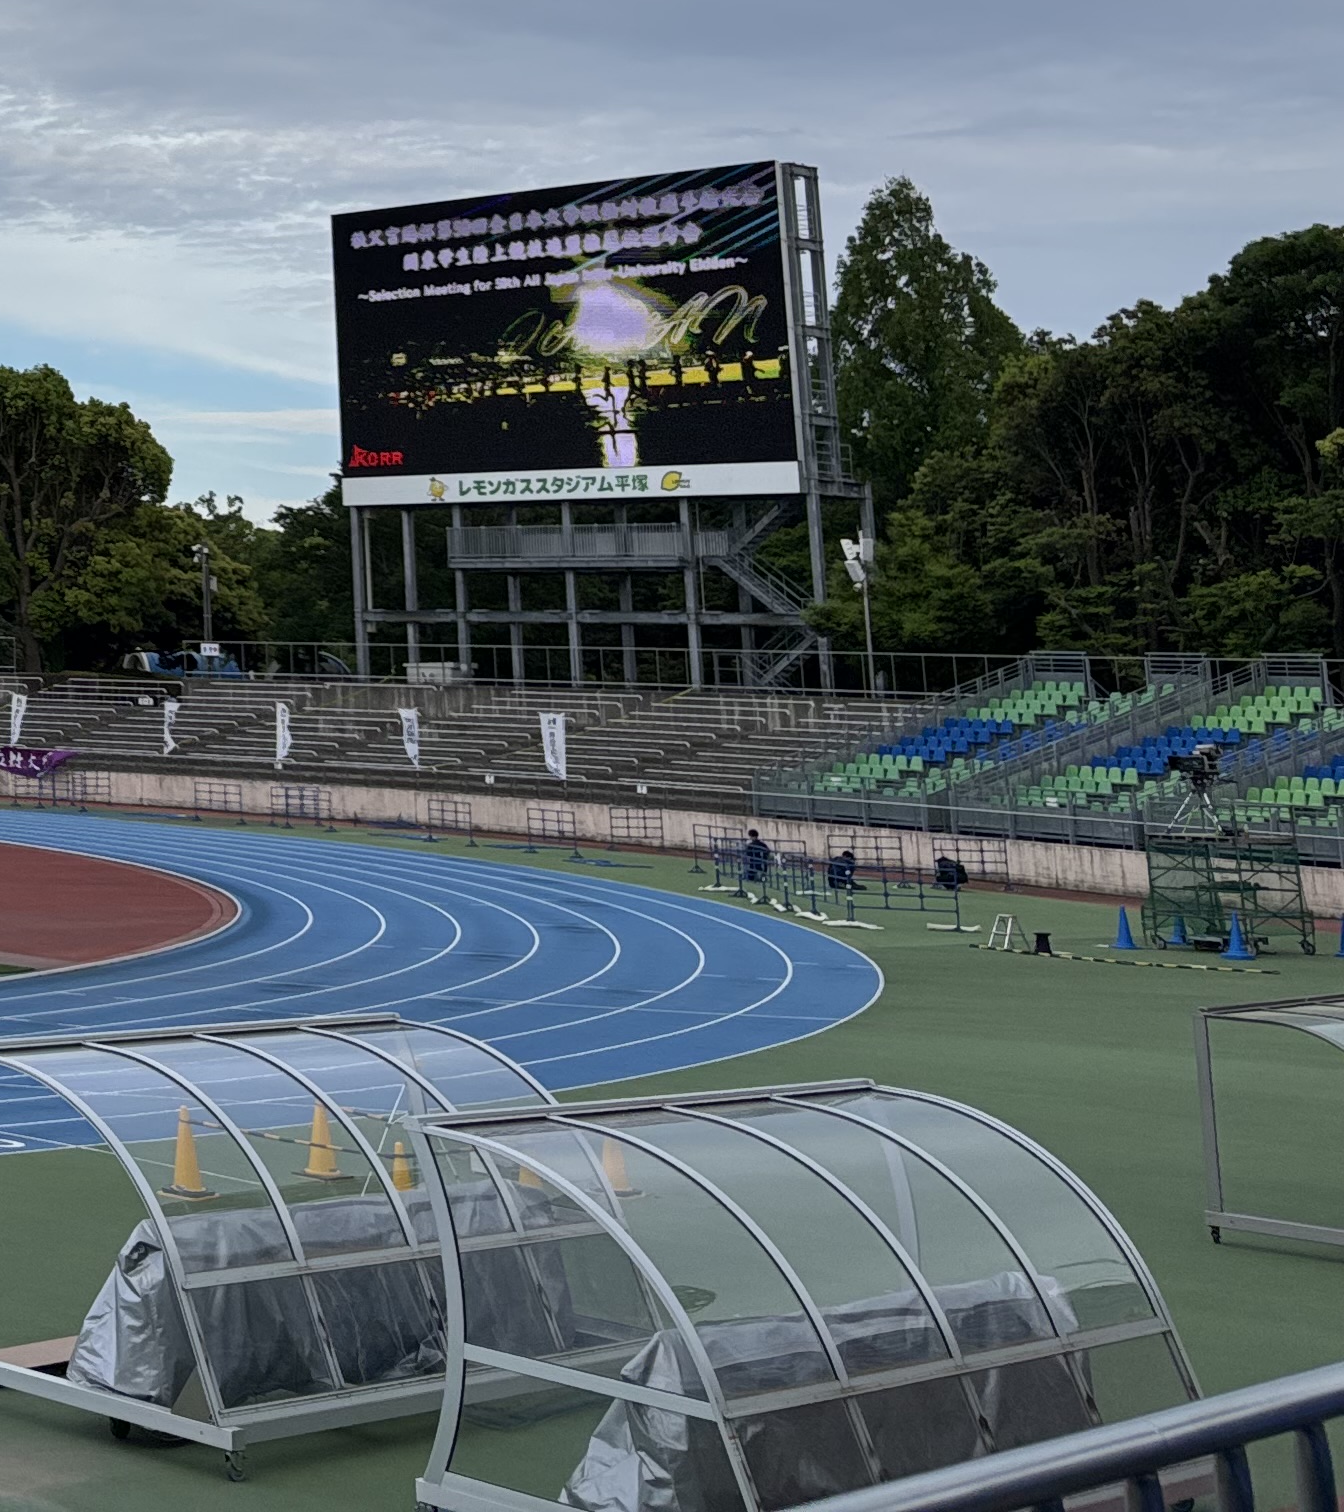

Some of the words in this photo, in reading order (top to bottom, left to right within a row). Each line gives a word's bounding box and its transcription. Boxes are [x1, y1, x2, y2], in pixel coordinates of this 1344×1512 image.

[473, 279, 493, 292] for
[523, 274, 541, 287] All
[458, 474, 649, 497] レモンガススタジアム平塚
